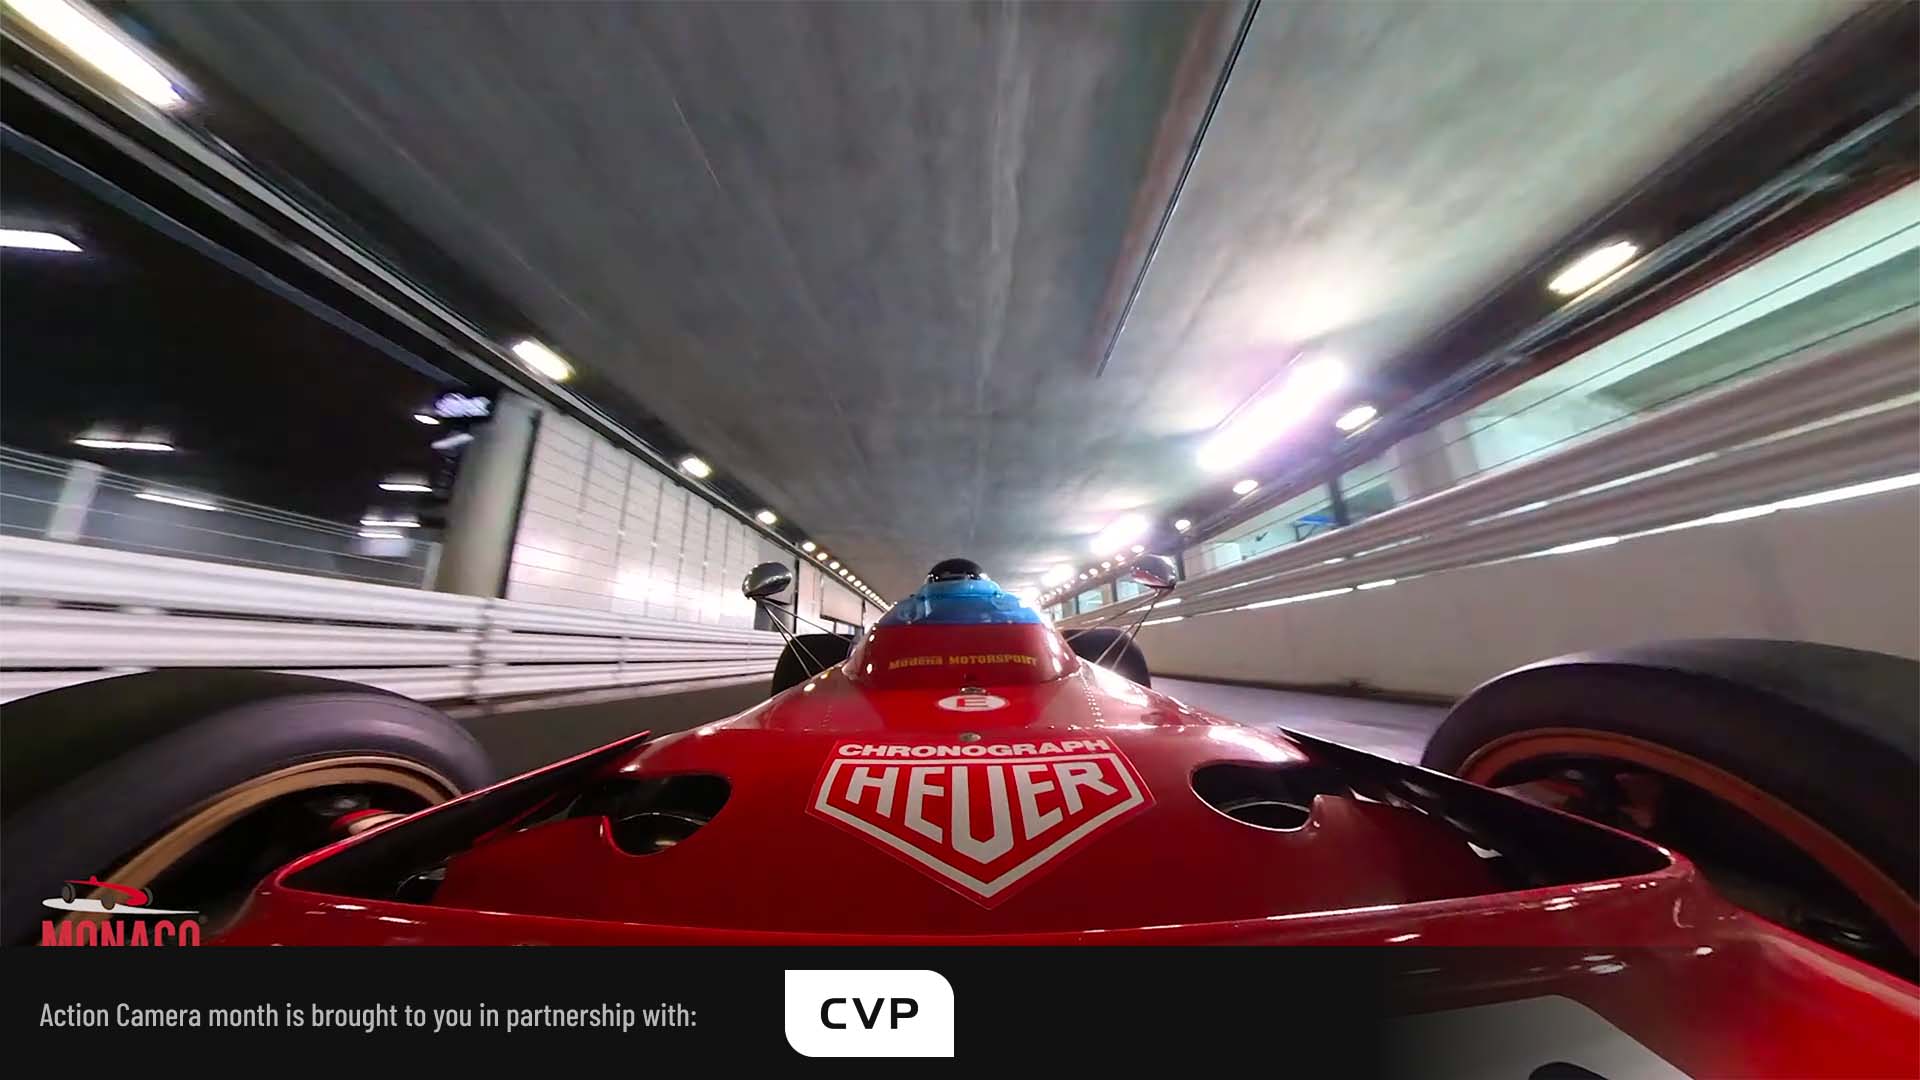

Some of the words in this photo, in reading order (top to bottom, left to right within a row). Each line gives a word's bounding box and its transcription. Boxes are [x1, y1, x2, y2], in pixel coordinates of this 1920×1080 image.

[949, 654, 1037, 667] MOTORSPORT
[956, 697, 988, 708] E
[838, 739, 1110, 757] CHRONOGRAPH
[845, 761, 1119, 864] HEUER
